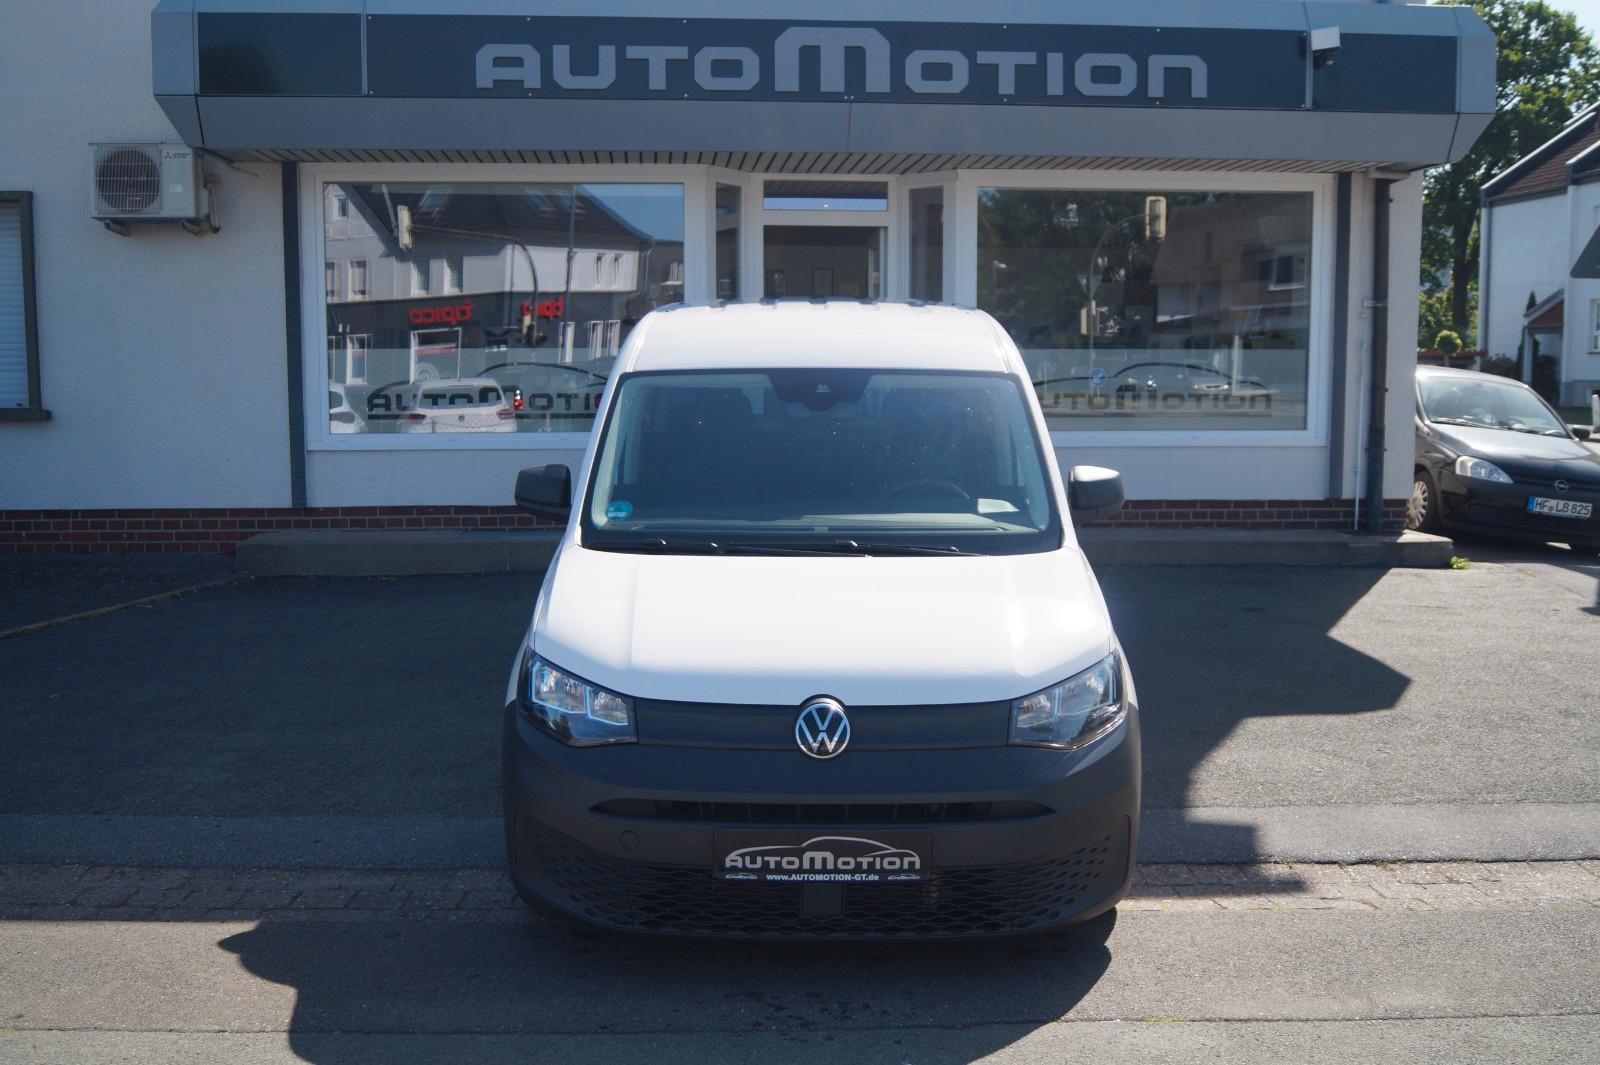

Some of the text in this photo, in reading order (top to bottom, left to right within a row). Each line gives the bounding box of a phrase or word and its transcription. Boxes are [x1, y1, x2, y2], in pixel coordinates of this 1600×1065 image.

[475, 26, 1208, 98] AUTOMOTION
[1036, 384, 1272, 410] UTOMOTION
[1535, 499, 1591, 516] HF LB 825
[725, 851, 921, 870] AUTOMOTION
[766, 873, 879, 881] www.AUTOMOTION-GT.de
